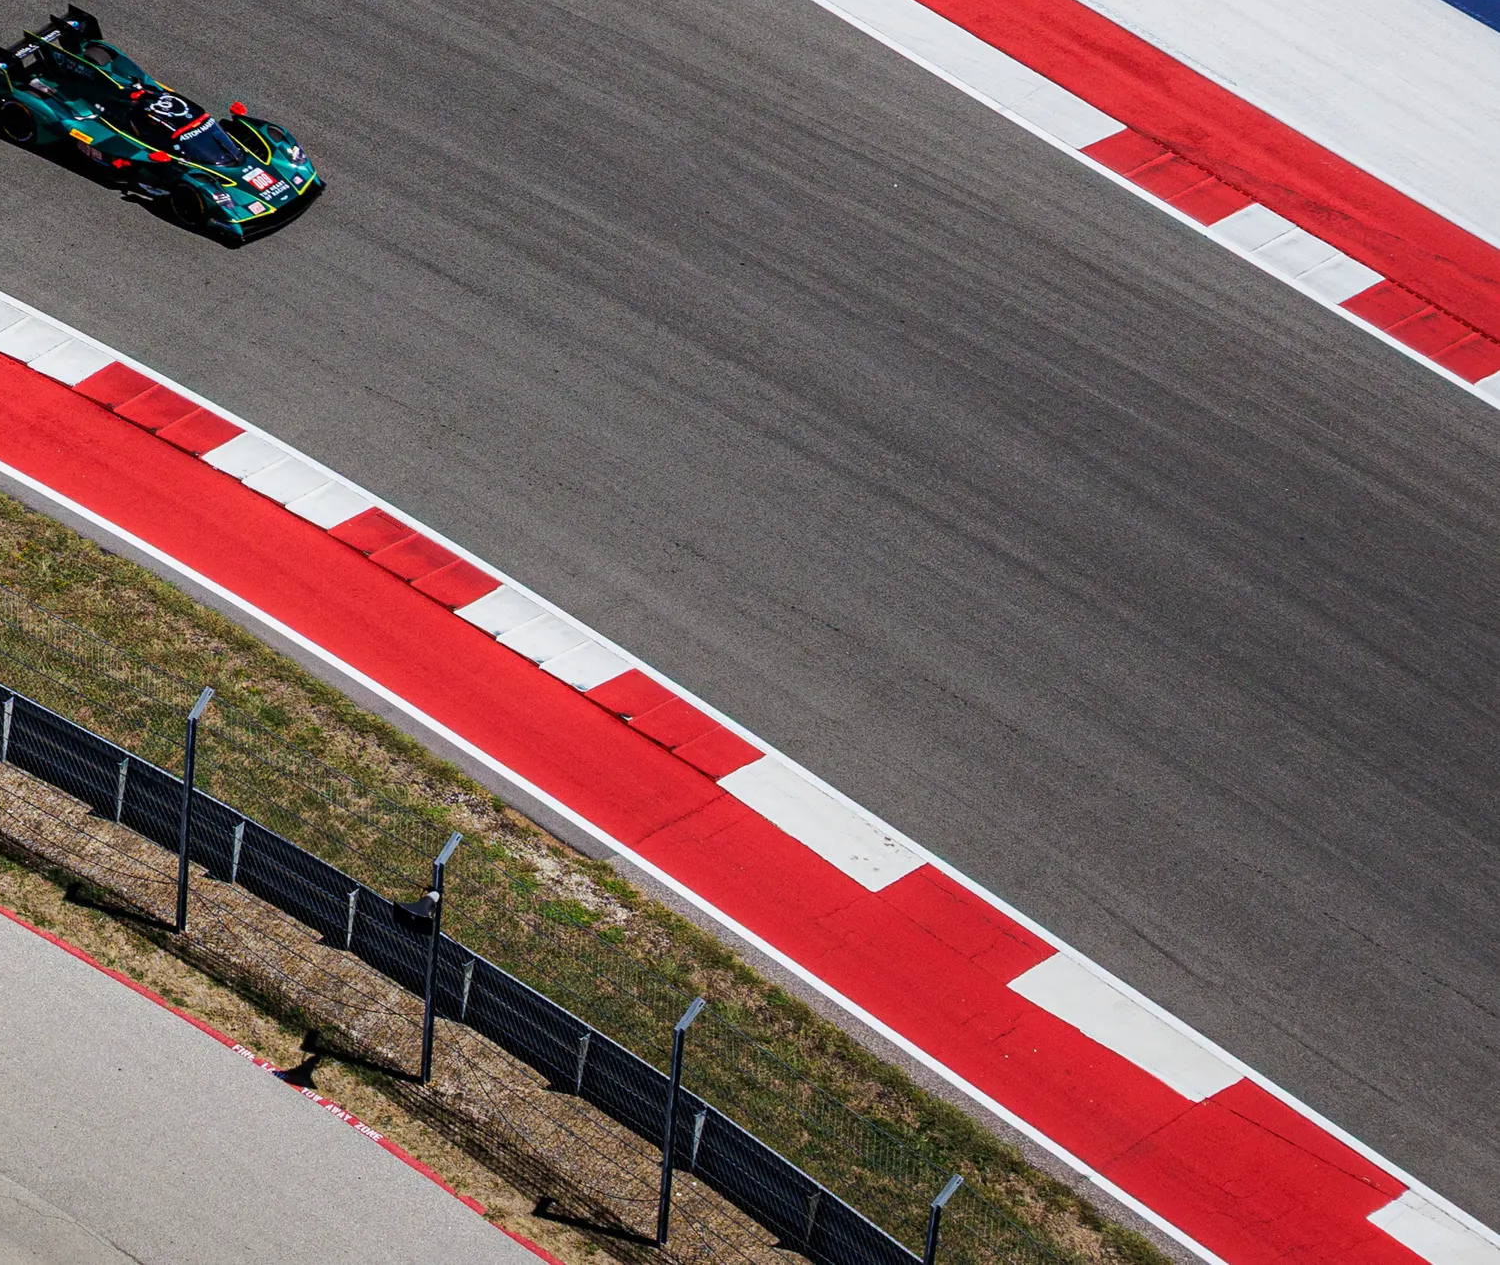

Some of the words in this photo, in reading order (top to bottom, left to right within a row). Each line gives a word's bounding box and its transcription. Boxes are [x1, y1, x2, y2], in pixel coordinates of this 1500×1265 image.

[180, 128, 202, 142] ASTON
[251, 173, 274, 190] 009
[231, 1044, 256, 1062] FIRE
[325, 1103, 353, 1121] AWAY
[354, 1122, 384, 1142] ZONE
